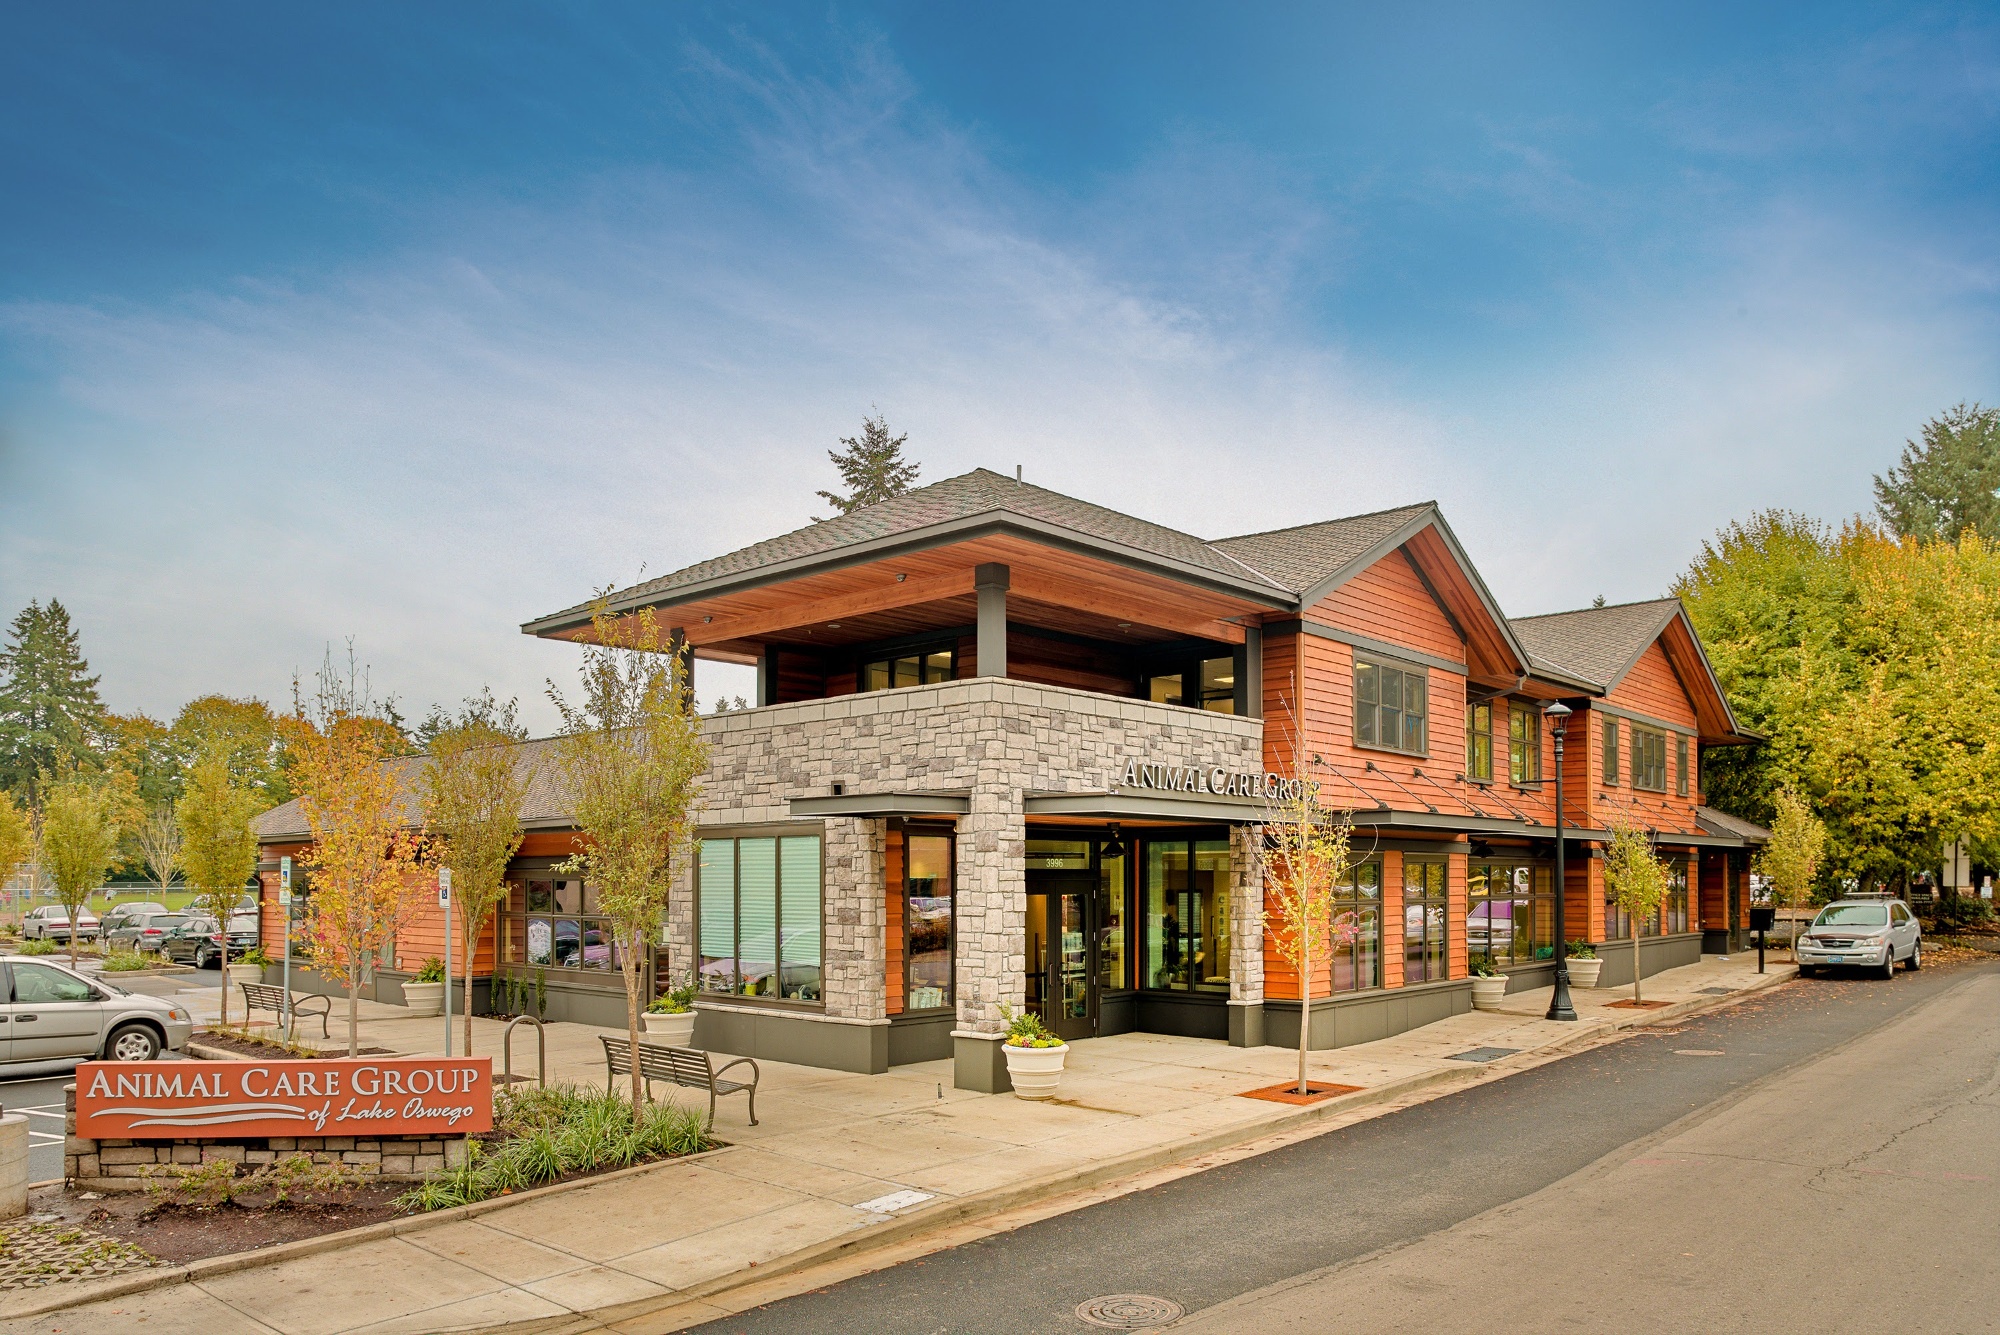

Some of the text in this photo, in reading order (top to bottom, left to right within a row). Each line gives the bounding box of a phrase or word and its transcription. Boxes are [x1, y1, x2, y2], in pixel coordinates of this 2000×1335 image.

[1120, 757, 1321, 805] ANIMAL CARE GROP
[1046, 858, 1064, 868] 3996
[86, 1066, 480, 1099] ANIMAL CARE GROUP
[307, 1097, 473, 1132] of Lake Oswego
